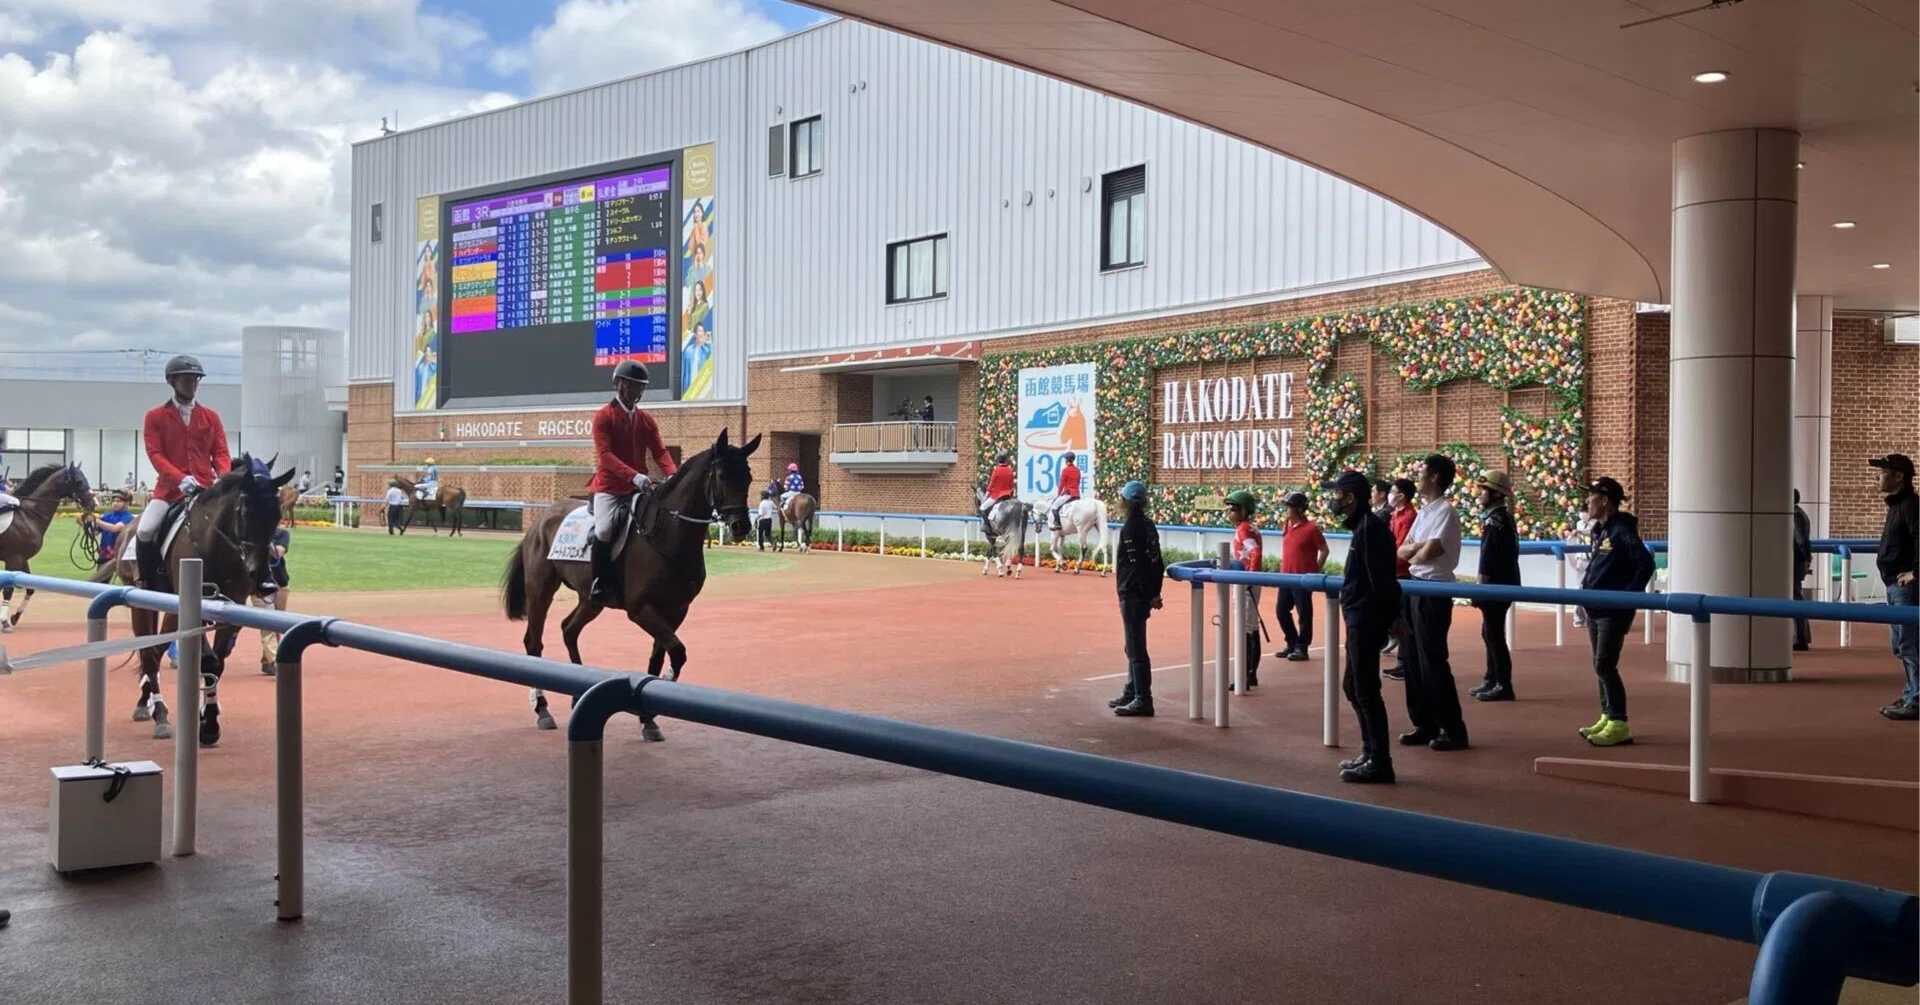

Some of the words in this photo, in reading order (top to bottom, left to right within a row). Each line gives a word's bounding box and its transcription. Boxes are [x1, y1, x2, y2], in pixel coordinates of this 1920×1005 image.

[475, 204, 489, 219] 3R
[595, 319, 611, 328] ワイド
[1025, 373, 1089, 397] 函館競馬場
[1163, 372, 1294, 425] HAKODATE
[456, 421, 523, 438] HAKODATE
[538, 420, 593, 436] RACECO
[1162, 428, 1293, 470] RACECOURSE
